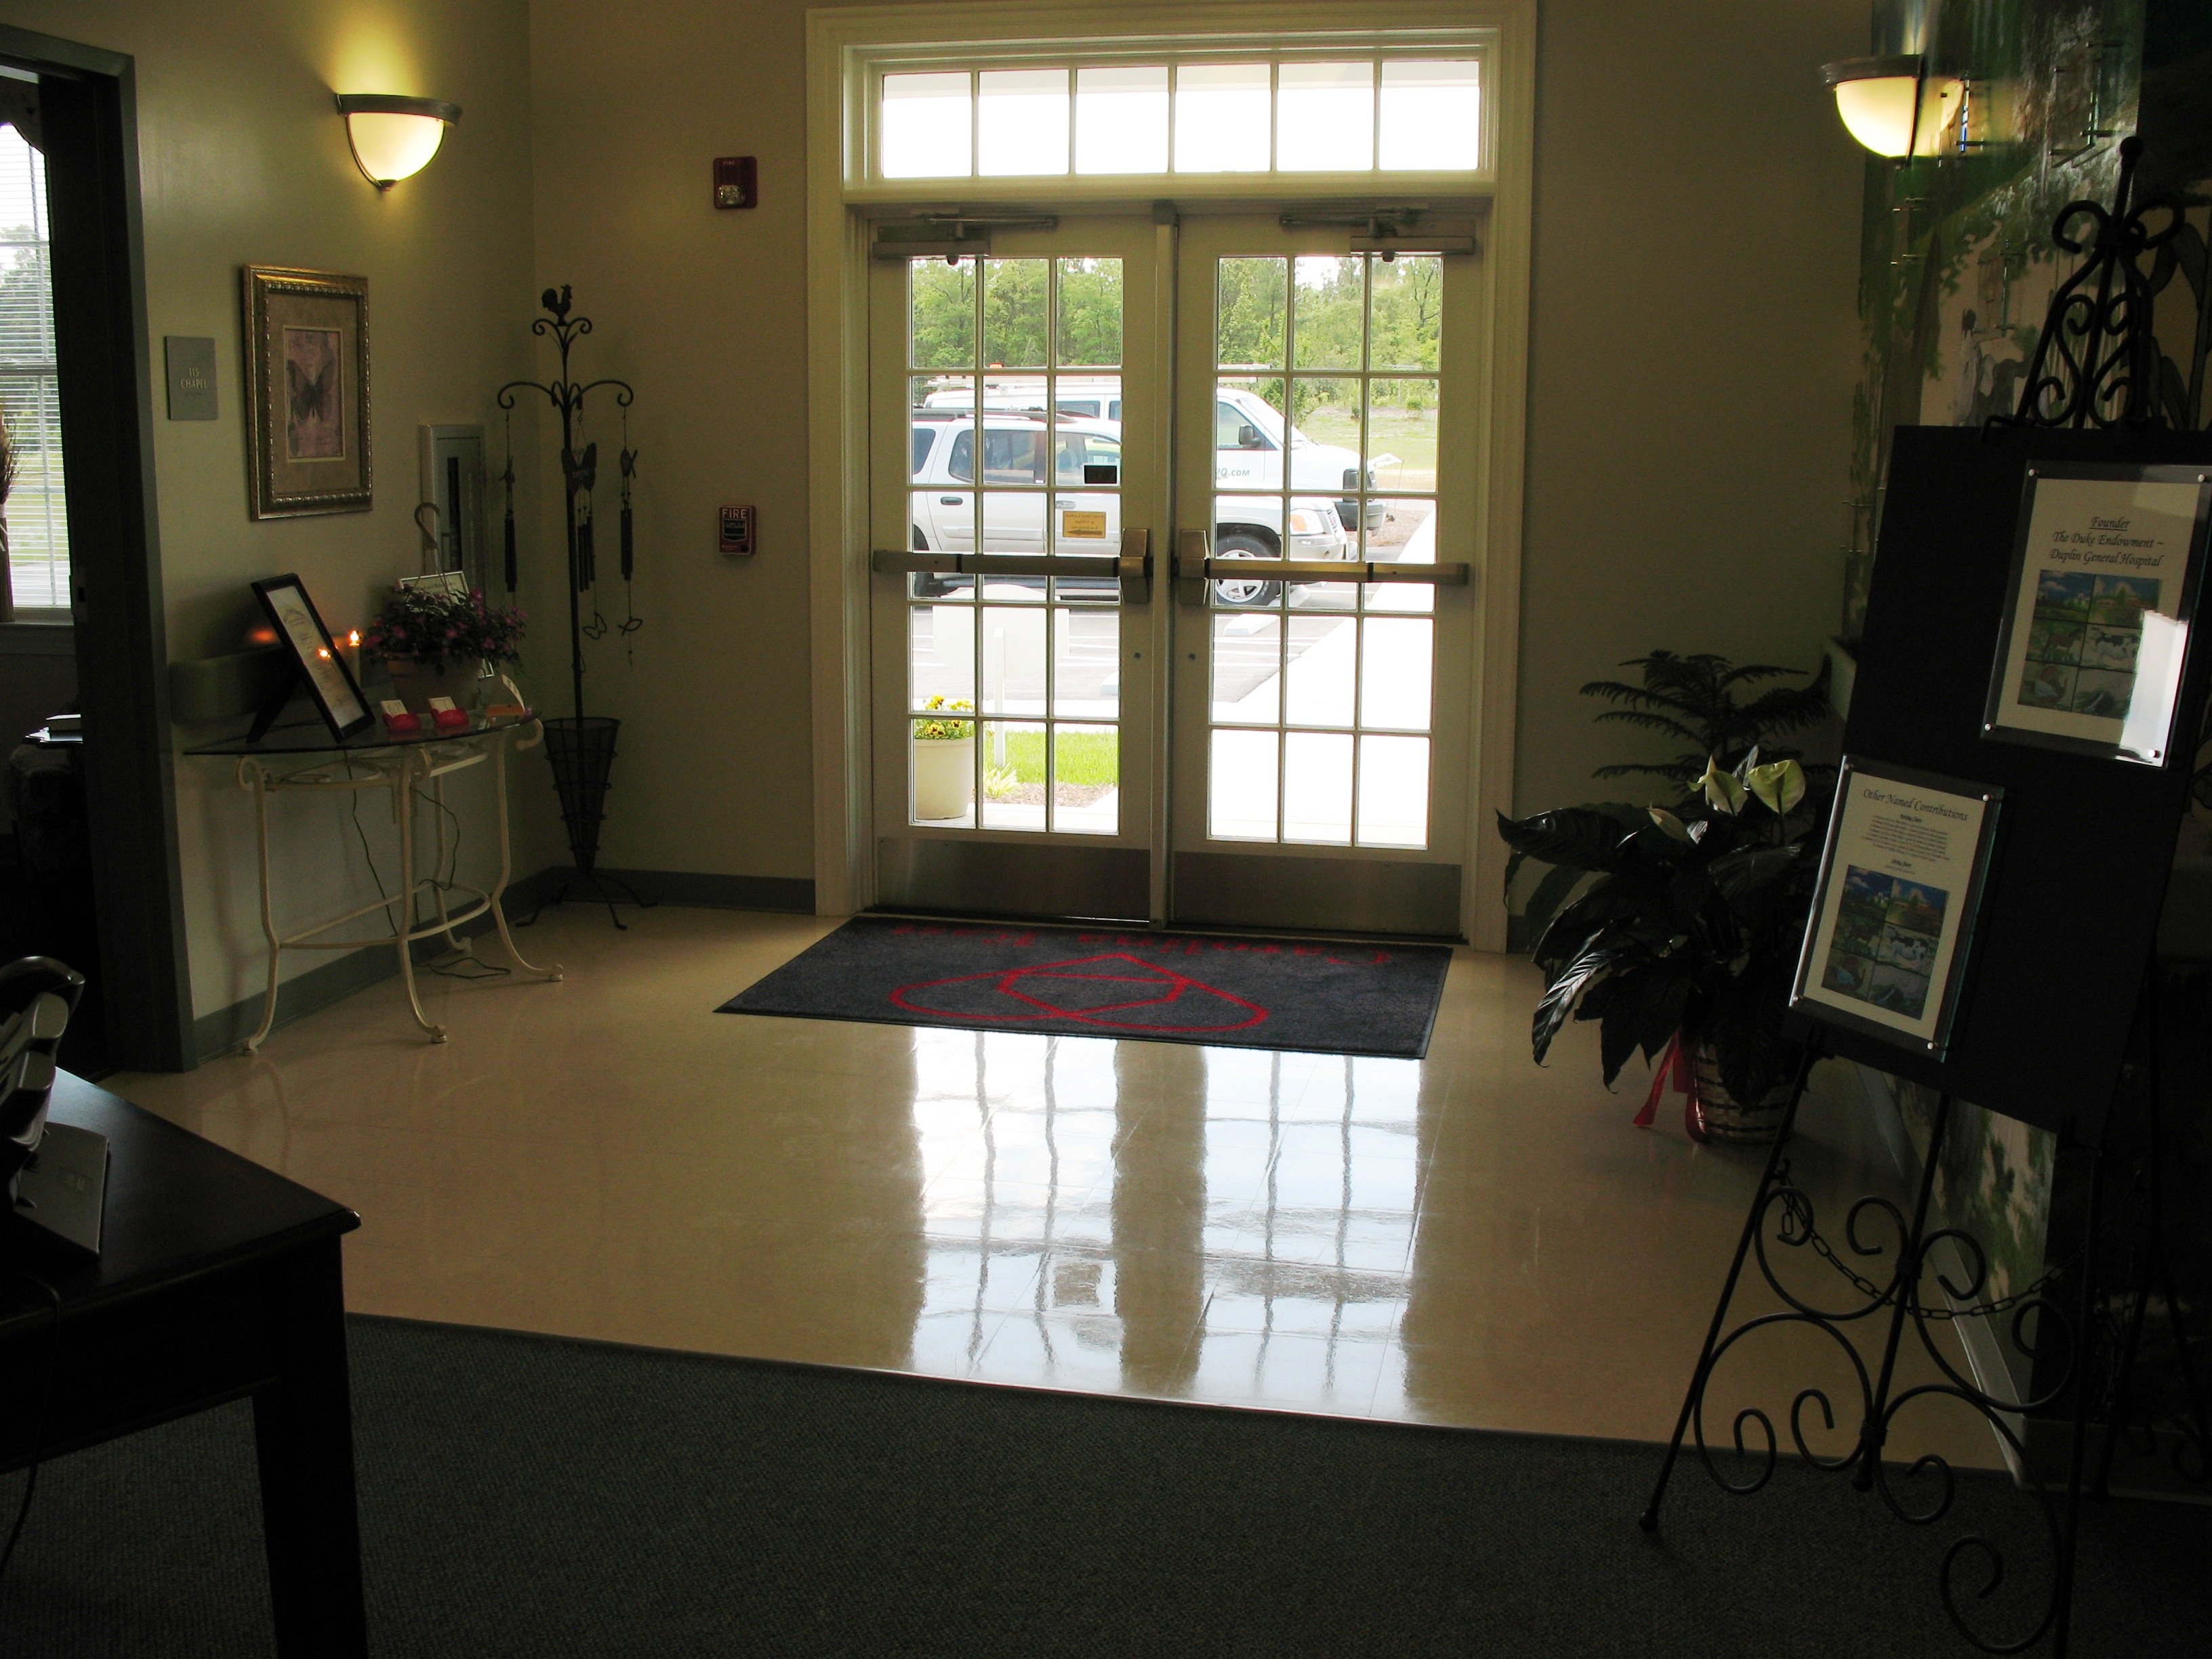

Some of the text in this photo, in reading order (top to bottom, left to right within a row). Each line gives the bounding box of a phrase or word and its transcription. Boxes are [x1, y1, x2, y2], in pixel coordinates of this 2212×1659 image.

[180, 378, 206, 389] CHAPEL
[722, 508, 747, 518] FIRE
[2091, 516, 2130, 529] Founder
[2053, 531, 2069, 542] The
[2070, 532, 2095, 547] Duke
[2098, 534, 2154, 548] Endowment
[2051, 548, 2165, 569] Duplin General Hospital
[1863, 789, 1885, 801] Other
[1885, 794, 1915, 808] Named
[1914, 800, 1969, 821] Contributions
[1078, 933, 1391, 965] Carolina
